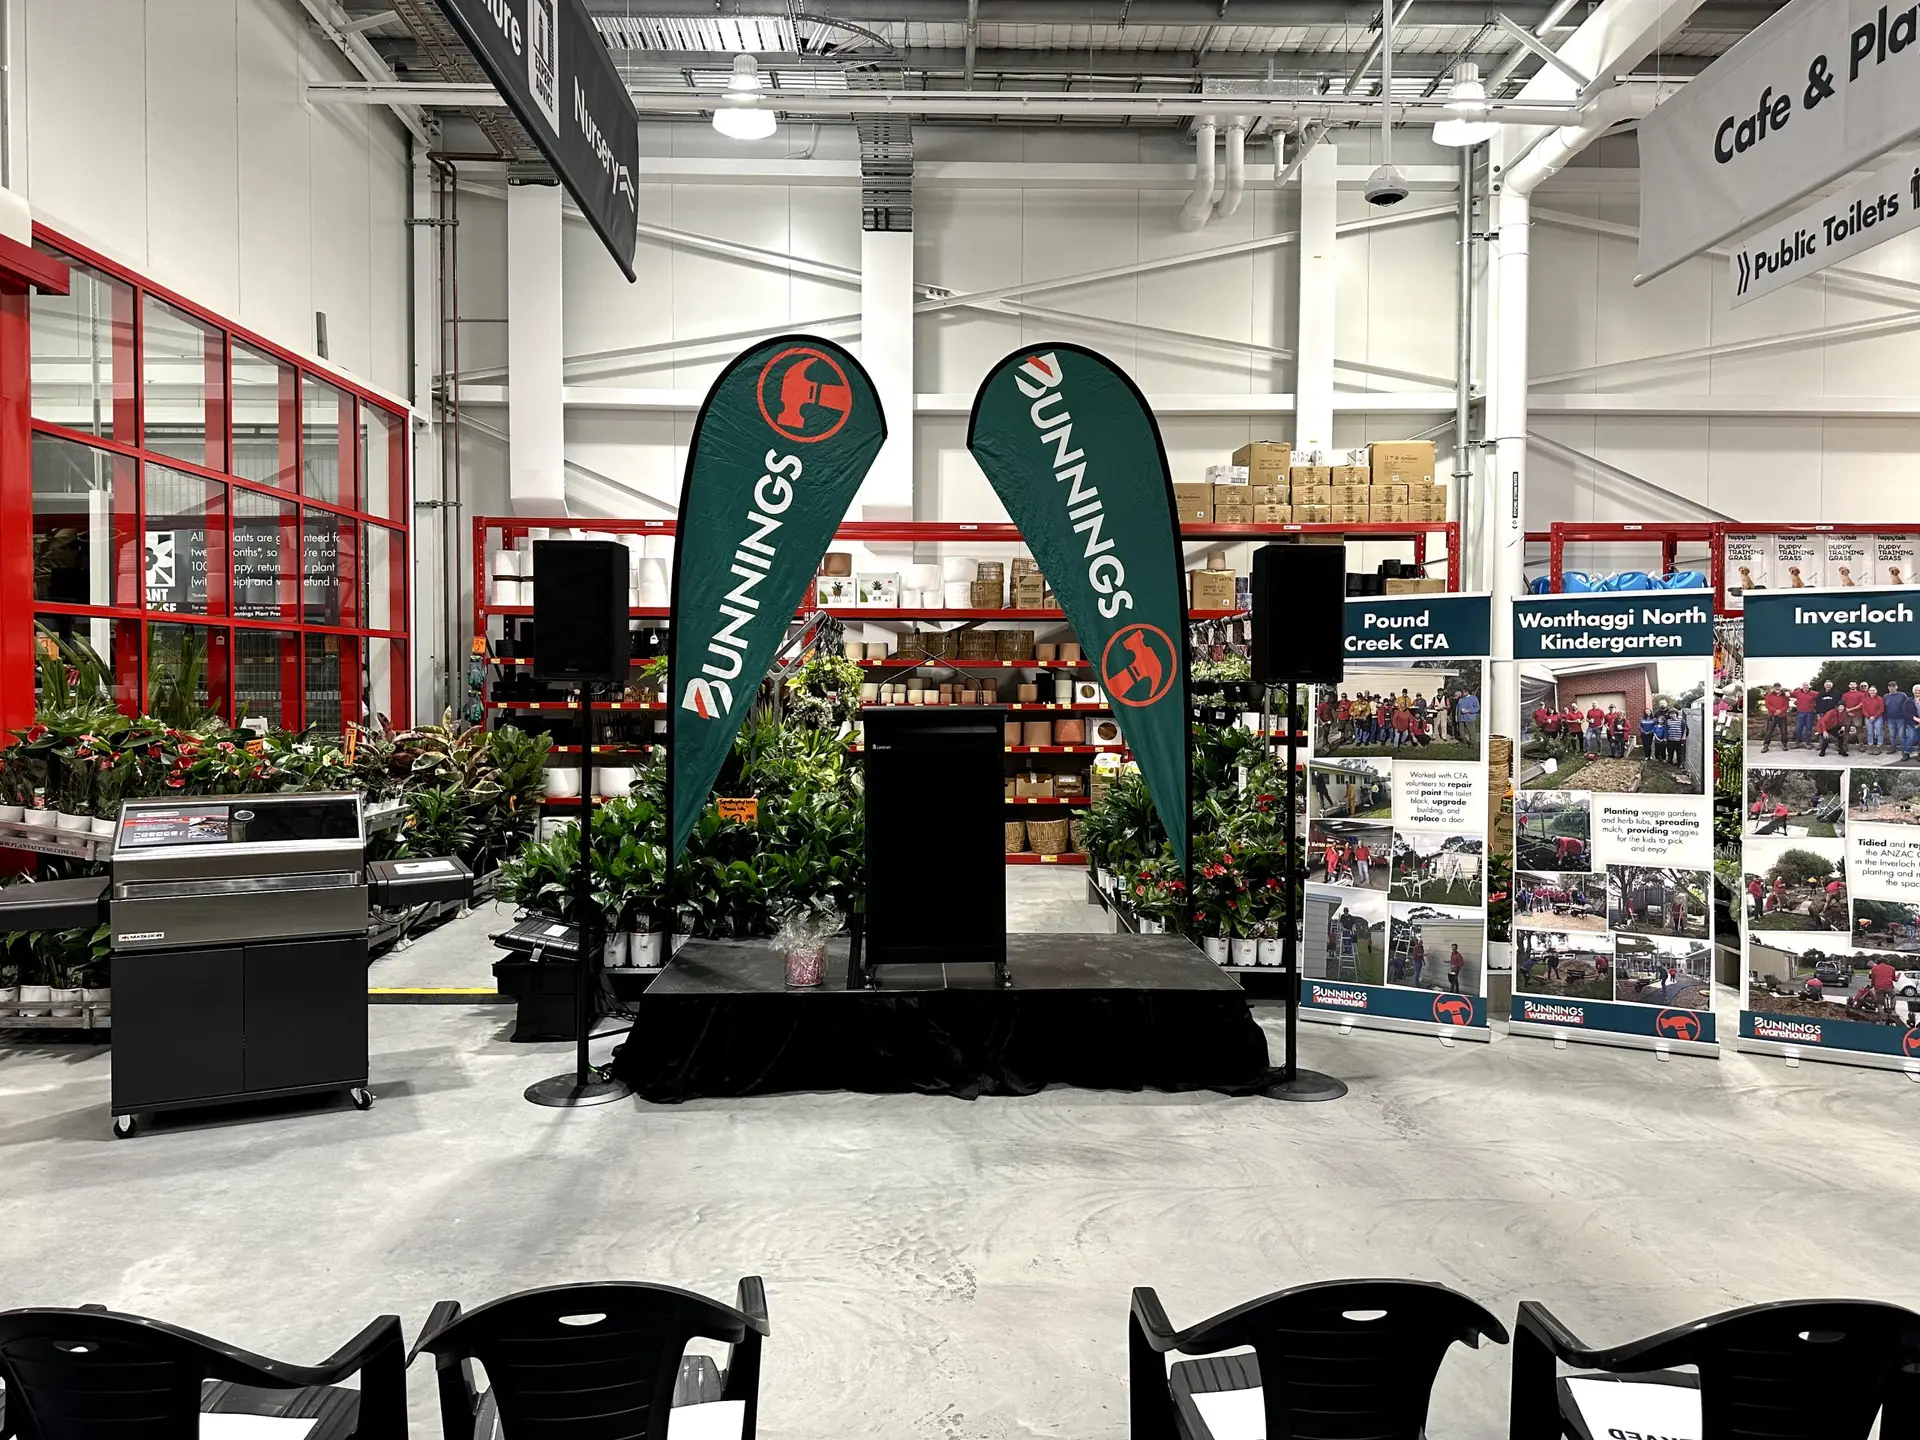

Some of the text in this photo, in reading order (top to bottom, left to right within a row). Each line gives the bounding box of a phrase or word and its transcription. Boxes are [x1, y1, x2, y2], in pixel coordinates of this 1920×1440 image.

[1714, 5, 1920, 164] Cafe & Pla
[574, 76, 619, 195] Nursery
[1755, 193, 1899, 280] Public Toilets
[1013, 351, 1133, 619] BUNNINGS
[191, 531, 204, 542] All
[257, 533, 272, 542] are
[321, 549, 336, 557] not
[312, 560, 335, 573] plant
[254, 576, 272, 586] and
[681, 448, 803, 720] BUNNINGS
[1364, 610, 1430, 629] Pound
[1518, 606, 1707, 631] Wonthaggi North
[1795, 603, 1914, 624] Inverloch
[1344, 633, 1450, 651] Creek CFA
[1541, 632, 1683, 653] Kindergarten
[1831, 630, 1877, 649] RSL
[1410, 771, 1436, 779] Worked
[1448, 781, 1472, 789] repair
[1410, 797, 1467, 806] block, upgrade
[1604, 807, 1697, 818] Planting veggie gardens
[1655, 819, 1699, 828] spreading
[1602, 826, 1624, 834] mulch,
[1627, 827, 1668, 836] providing
[1668, 837, 1683, 845] pick
[1858, 838, 1887, 847] Tidied
[1890, 840, 1906, 848] and
[1631, 844, 1667, 854] and enjoy
[1865, 848, 1878, 856] the
[1880, 850, 1914, 858] ANZAC
[1880, 859, 1916, 867] Inverloch
[1862, 867, 1894, 878] planting
[1885, 878, 1898, 886] the
[1312, 985, 1368, 1001] BUNNINGS
[1316, 994, 1365, 1007] warehouse
[1524, 1000, 1584, 1016] BUNNINGS
[1528, 1011, 1581, 1023] warehouse
[1754, 1016, 1821, 1034] BUNNINGS
[1760, 1027, 1818, 1041] warehouse
